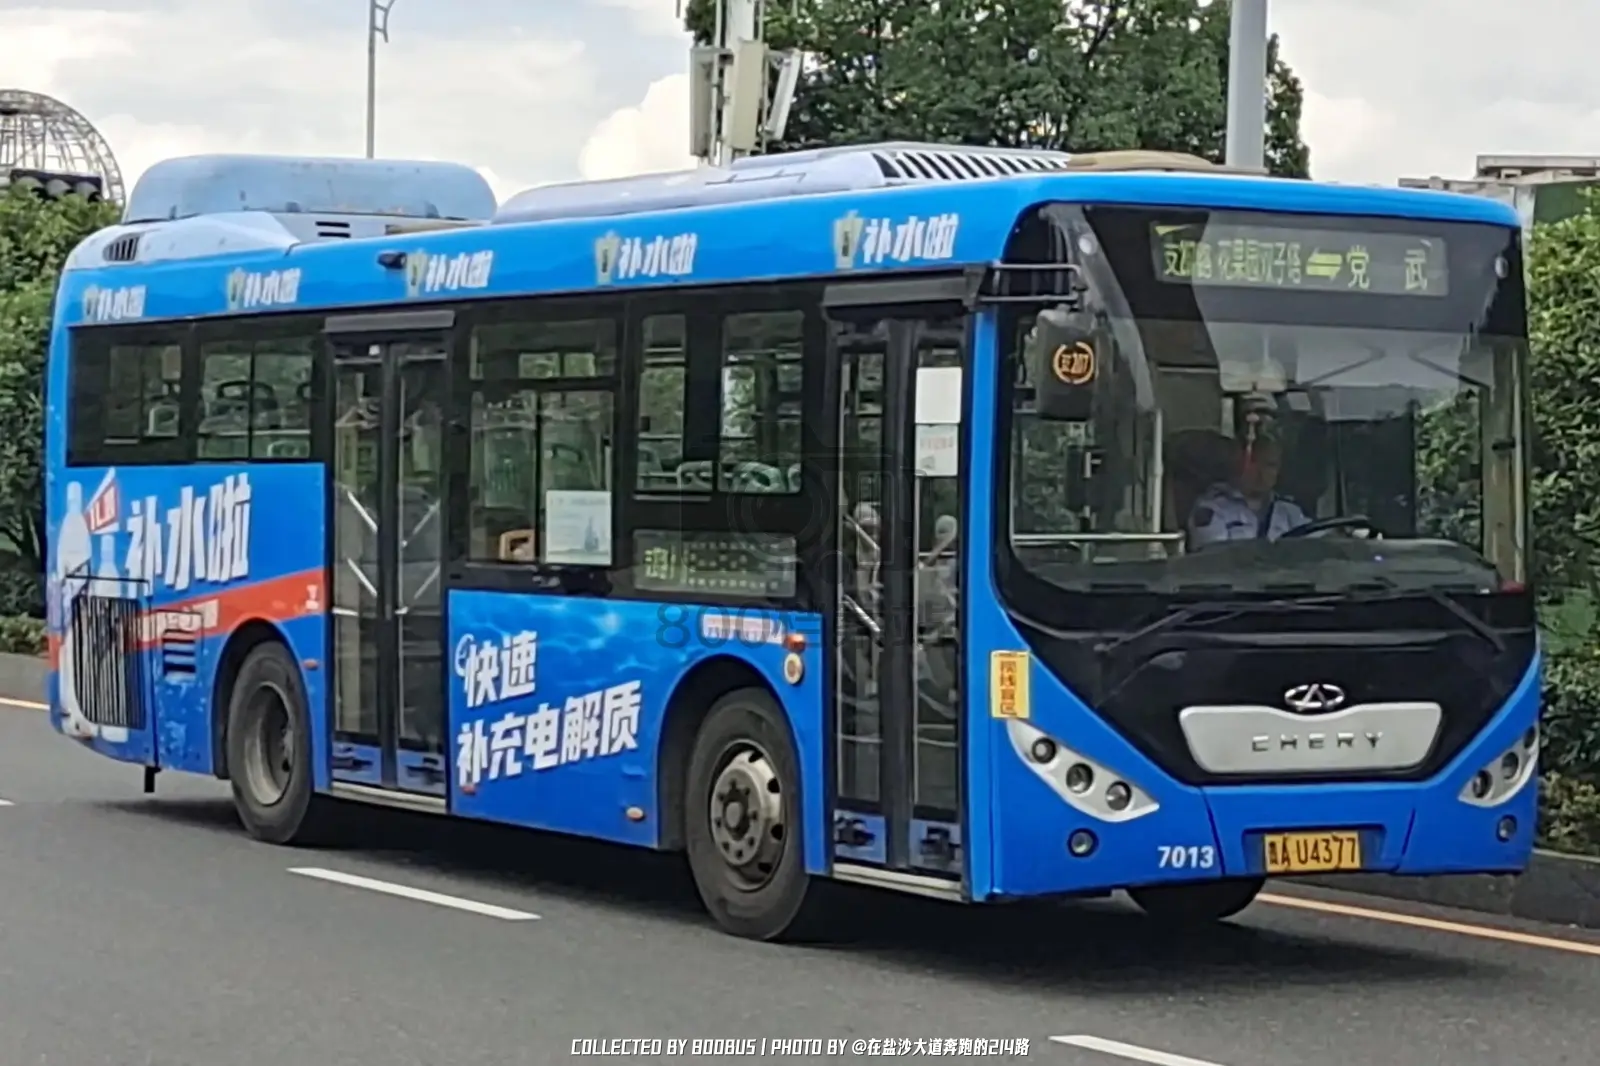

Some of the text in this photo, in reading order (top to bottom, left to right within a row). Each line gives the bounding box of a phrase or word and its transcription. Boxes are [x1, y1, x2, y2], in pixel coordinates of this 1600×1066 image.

[618, 233, 697, 280] 补水啦
[864, 213, 959, 263] 补水啦
[425, 251, 494, 292] 补水啦
[125, 472, 251, 599] 补水啦
[464, 629, 538, 708] 快速
[457, 680, 641, 787] 补充电解质
[1252, 731, 1384, 752] CHERY
[1157, 846, 1214, 869] 7013
